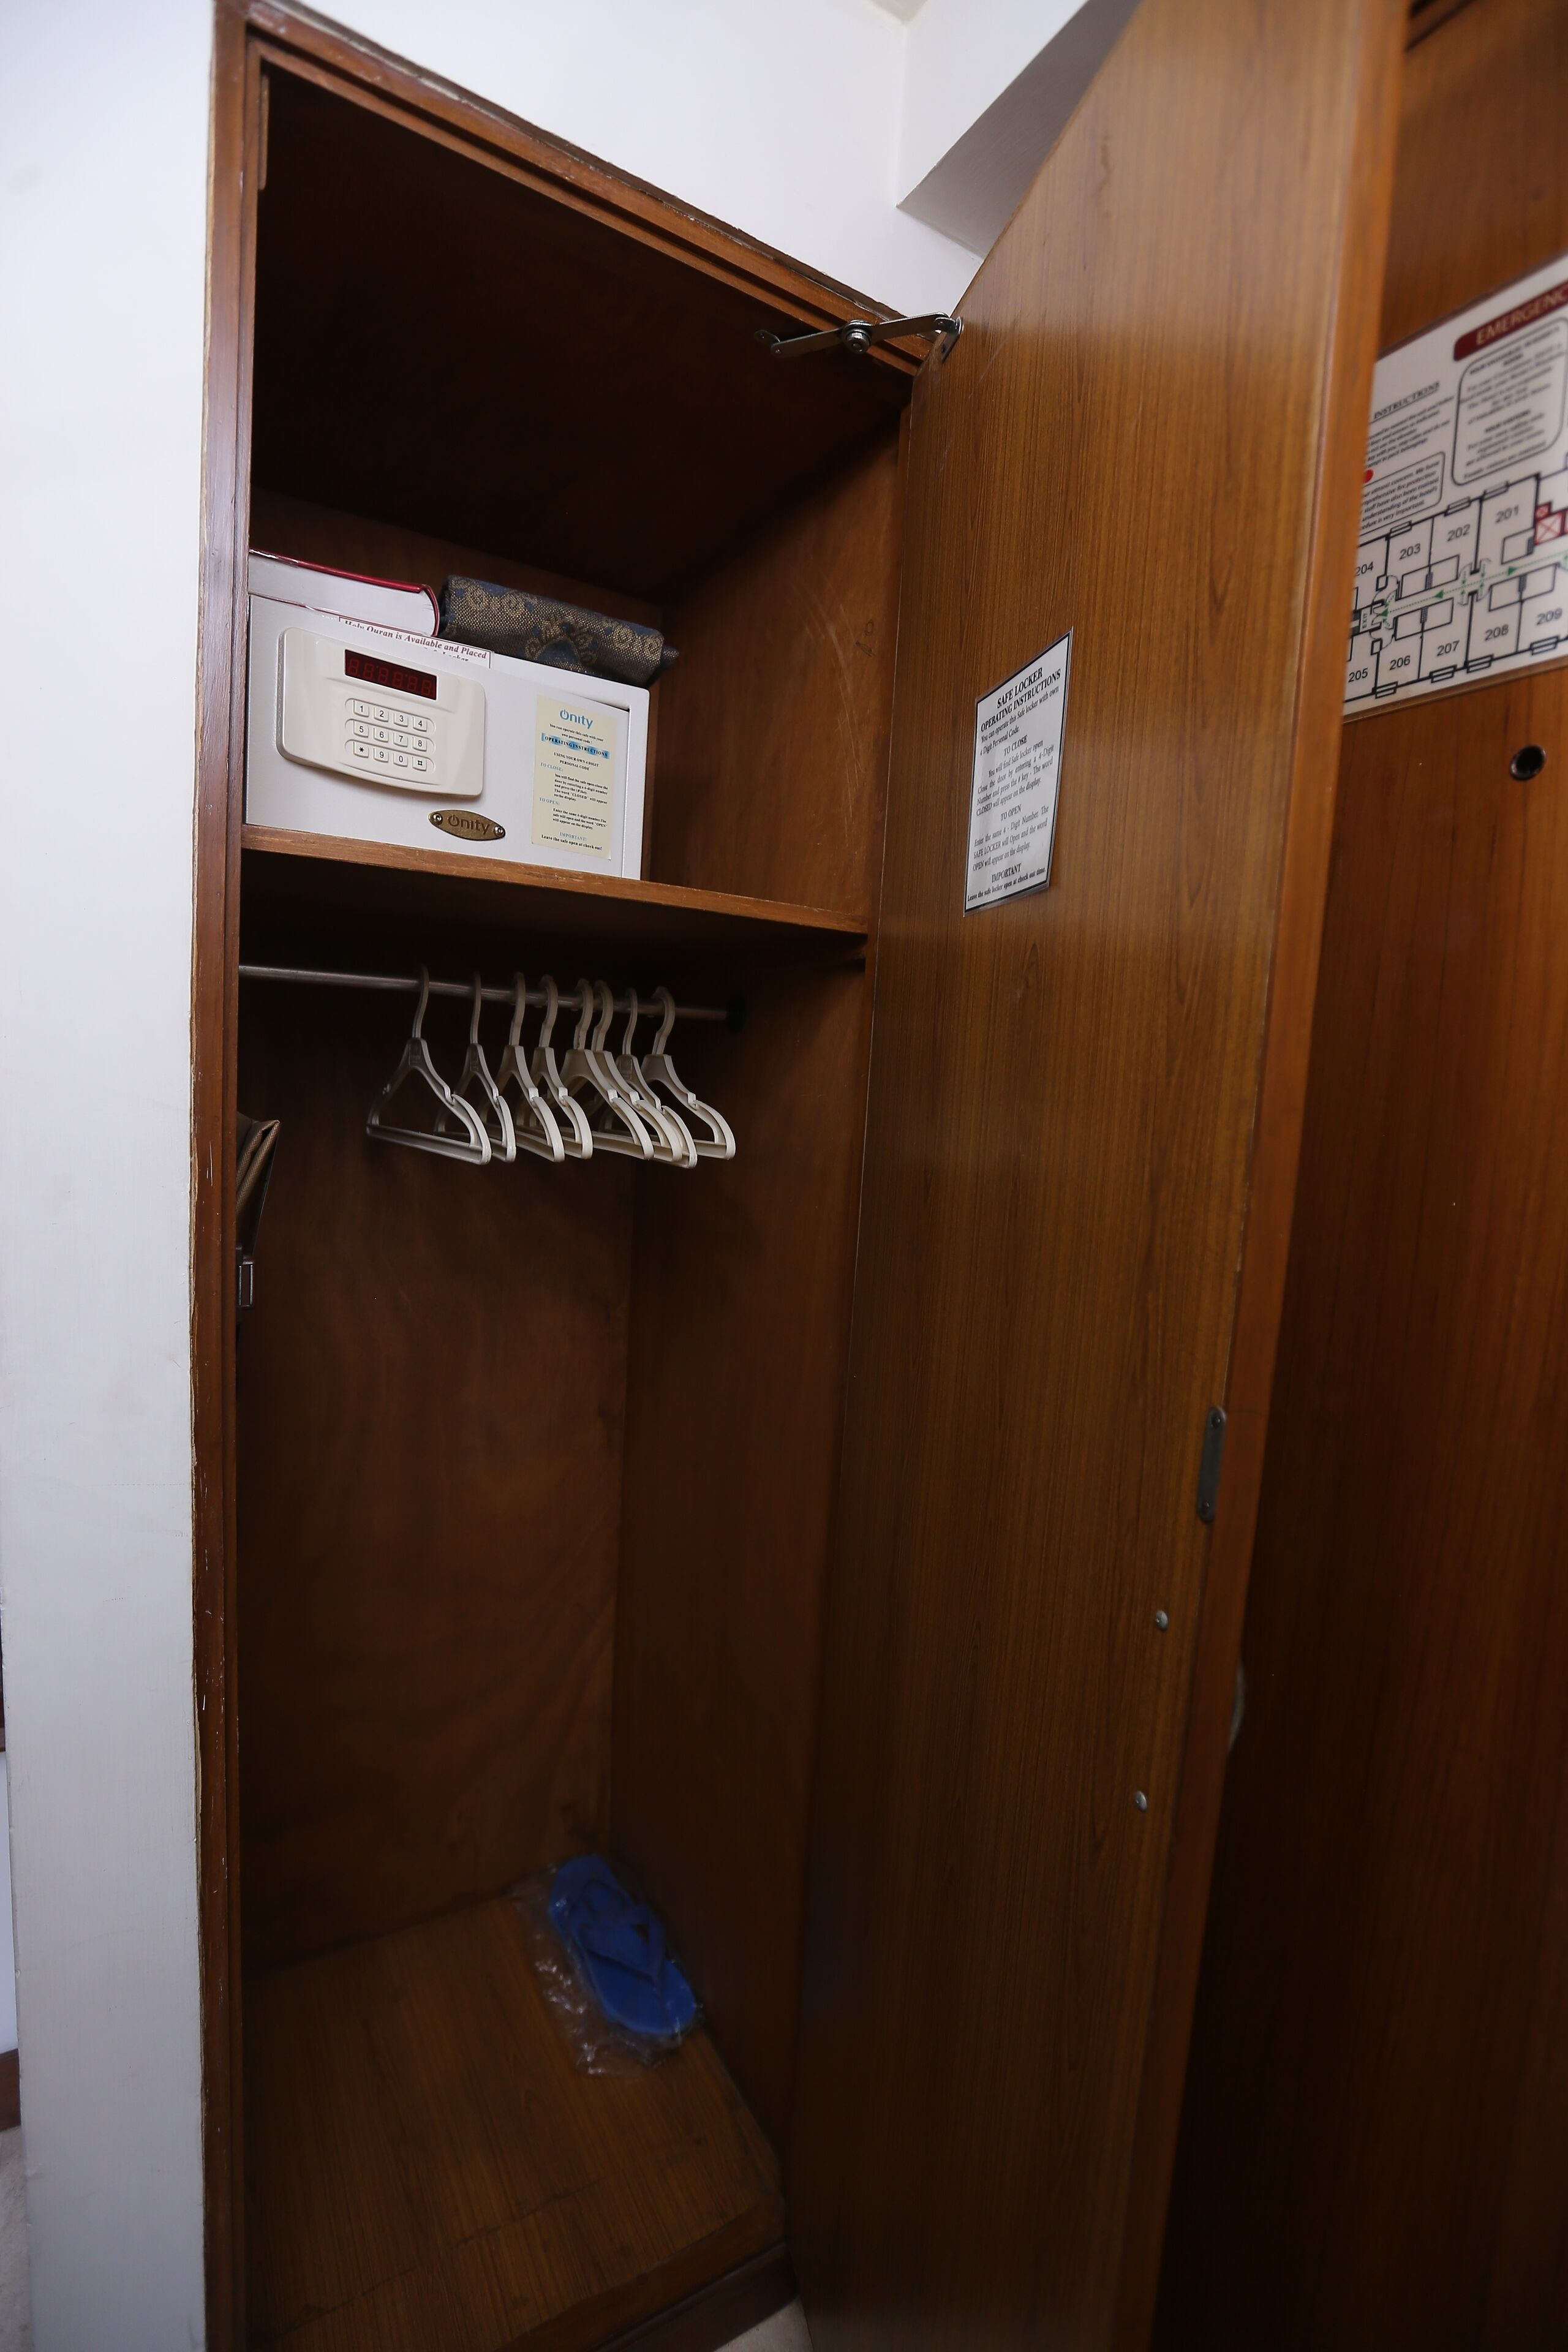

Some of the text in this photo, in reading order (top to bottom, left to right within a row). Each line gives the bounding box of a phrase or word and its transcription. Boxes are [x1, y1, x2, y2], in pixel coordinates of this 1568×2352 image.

[1374, 381, 1440, 418] INSTRUCTIONS
[1495, 505, 1520, 523] 201
[1447, 524, 1471, 541] 202
[1399, 543, 1421, 559] 203
[1355, 562, 1373, 576] 204
[1536, 608, 1563, 625] 209
[1485, 625, 1509, 641] 208
[404, 635, 442, 649] Available
[461, 647, 487, 659] Placed
[1437, 640, 1460, 656] 207
[1389, 655, 1411, 670] 206
[1348, 668, 1368, 682] 205
[997, 667, 1042, 709] SAFE LOCKER
[981, 669, 1060, 732] OPERATING INSTRUCTIONS
[560, 709, 593, 729] Onity
[995, 720, 1009, 736] operate
[1026, 699, 1038, 714] locker
[1039, 691, 1049, 704] with
[1049, 686, 1059, 697] own
[545, 736, 608, 757] OPERATING INSTRUCTIONS
[983, 743, 992, 755] Digit
[993, 731, 1008, 748] Personal
[1004, 734, 1027, 756] TO CLOSE
[1020, 746, 1032, 759] locker
[1033, 740, 1043, 752] open
[978, 784, 988, 794] Close
[997, 774, 1006, 783] door
[1008, 769, 1014, 778] by
[1015, 759, 1031, 774] entering
[978, 793, 992, 805] Number
[1000, 783, 1010, 795] press
[1042, 756, 1053, 769] word
[976, 802, 992, 816] CLOSED
[1000, 793, 1012, 805] appear
[1001, 804, 1022, 821] TO OPEN
[447, 814, 491, 835] Onity
[974, 837, 984, 846] Enter
[992, 829, 1002, 839] same
[1011, 820, 1020, 831] Digit
[974, 848, 984, 859] SAFE
[984, 841, 1001, 855] LOCKER
[1009, 833, 1020, 845] Open
[1037, 818, 1047, 830] word
[973, 860, 984, 872] OPEN
[992, 854, 1004, 865] appear
[992, 863, 1021, 883] IMPORTANT
[992, 884, 1003, 892] locker
[1003, 881, 1012, 890] open
[1018, 873, 1028, 883] check
